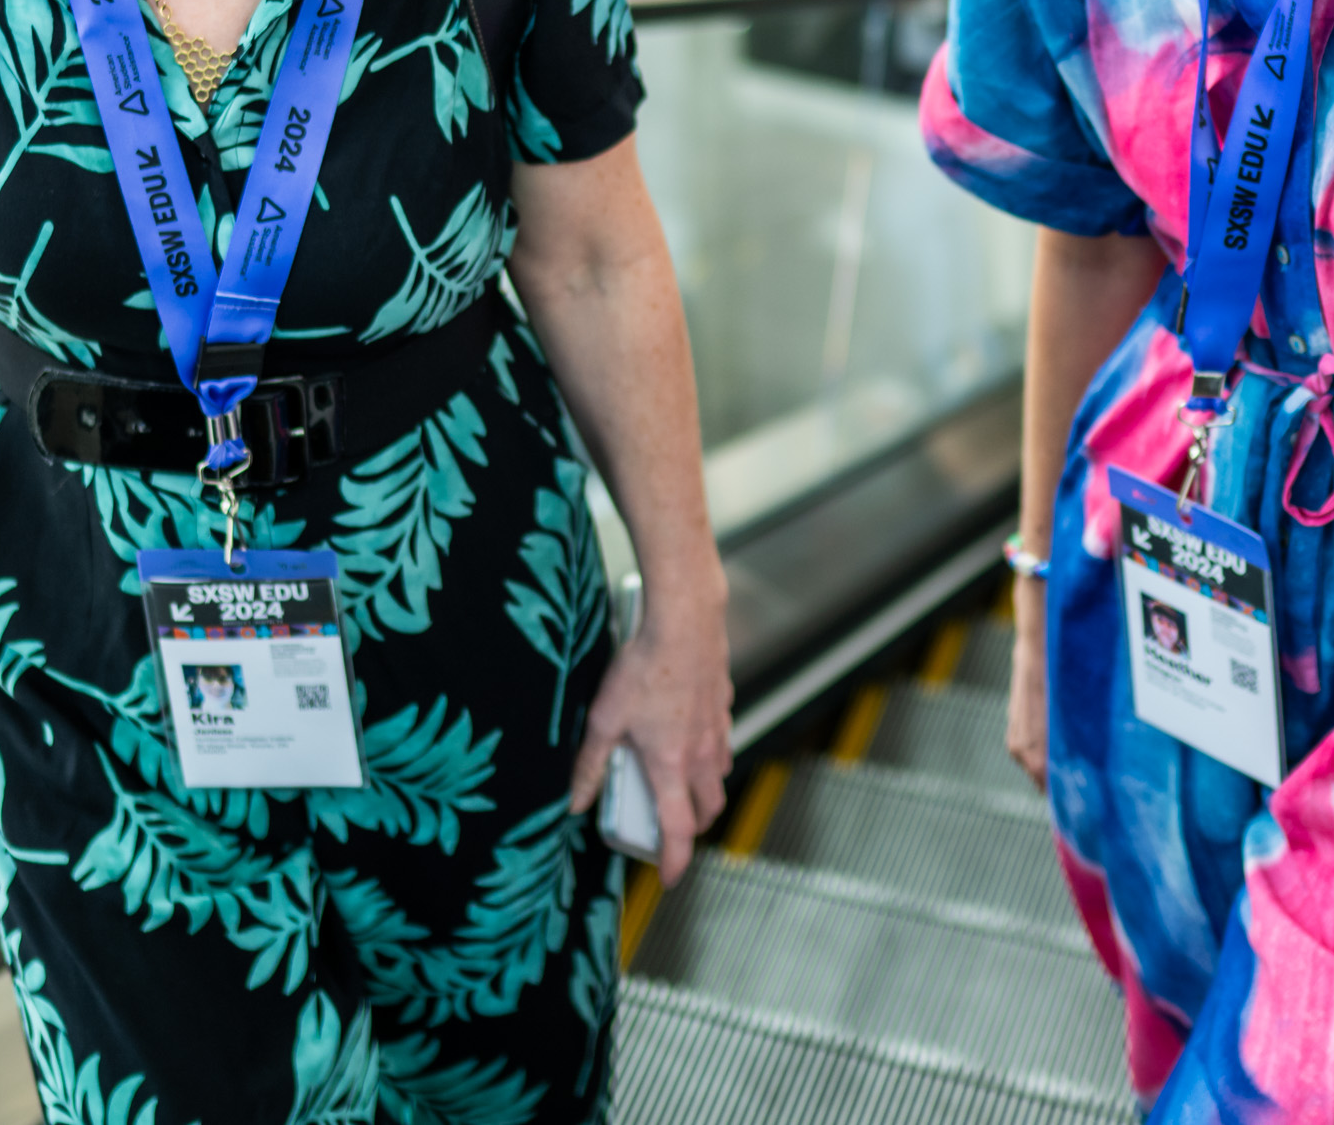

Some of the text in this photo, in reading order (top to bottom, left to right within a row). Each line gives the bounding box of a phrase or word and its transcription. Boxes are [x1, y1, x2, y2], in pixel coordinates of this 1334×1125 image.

[274, 106, 312, 173] 2024
[1223, 129, 1268, 251] SXSW EDU
[142, 174, 199, 298] SXSW EDU
[1147, 514, 1203, 555] SXSW
[1171, 545, 1225, 585] 2024
[187, 583, 309, 604] SXSW EDU
[219, 601, 284, 621] 2024
[191, 713, 235, 725] Kira
